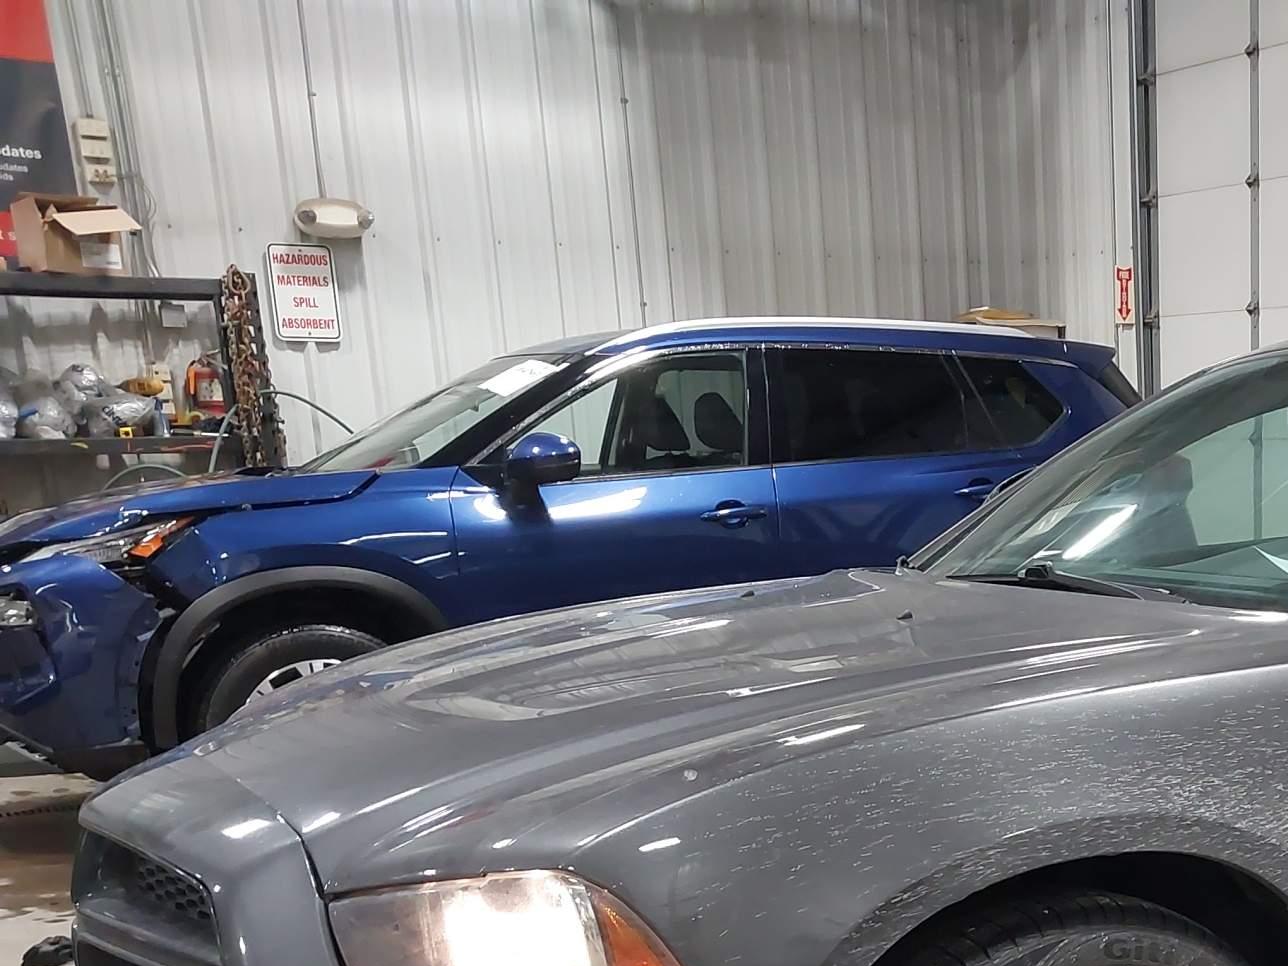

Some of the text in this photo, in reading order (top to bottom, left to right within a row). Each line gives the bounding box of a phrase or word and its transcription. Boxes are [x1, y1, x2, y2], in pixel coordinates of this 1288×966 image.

[0, 144, 43, 160] dates
[272, 253, 328, 266] HAZARDOUS
[277, 274, 329, 288] MATERIALS
[292, 296, 319, 308] SPILL
[281, 317, 335, 330] ABSORBENT
